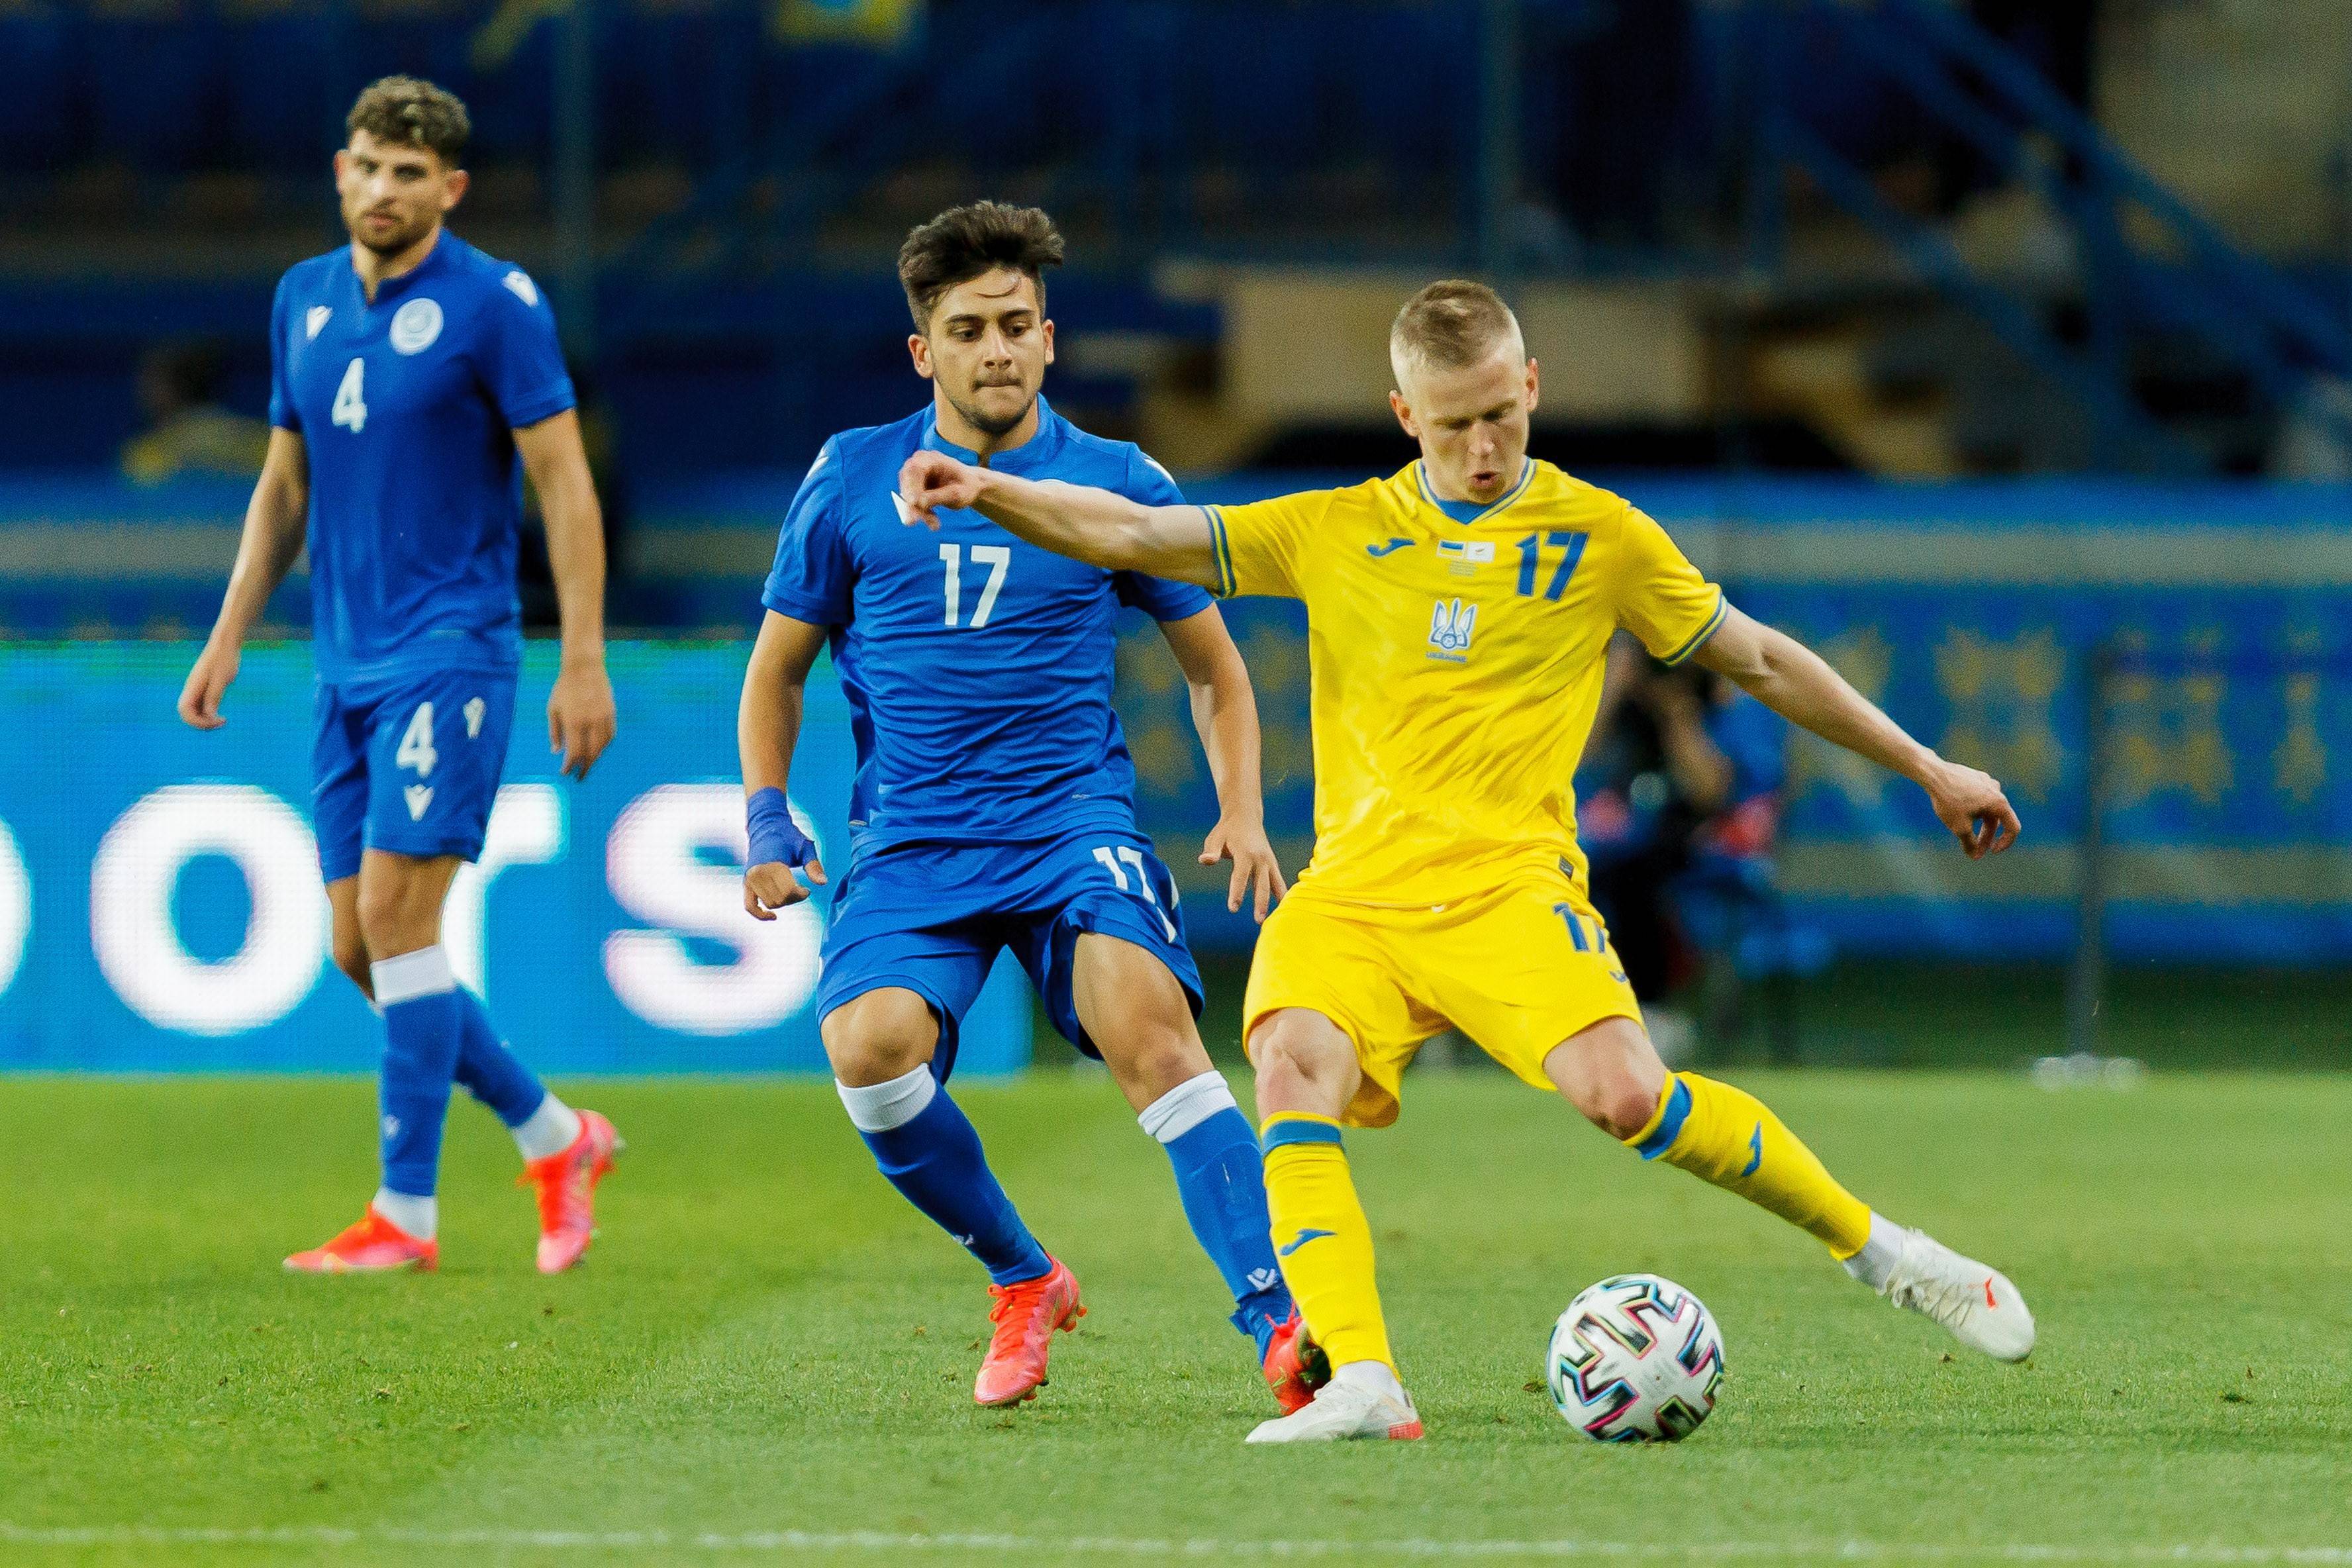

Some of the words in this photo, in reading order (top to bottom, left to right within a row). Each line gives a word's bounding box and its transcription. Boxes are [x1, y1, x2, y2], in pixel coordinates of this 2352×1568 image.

[332, 357, 368, 433] 4
[939, 543, 1010, 628] 17
[1516, 530, 1590, 602] 17
[397, 701, 438, 778] 4
[1093, 846, 1156, 905] 17
